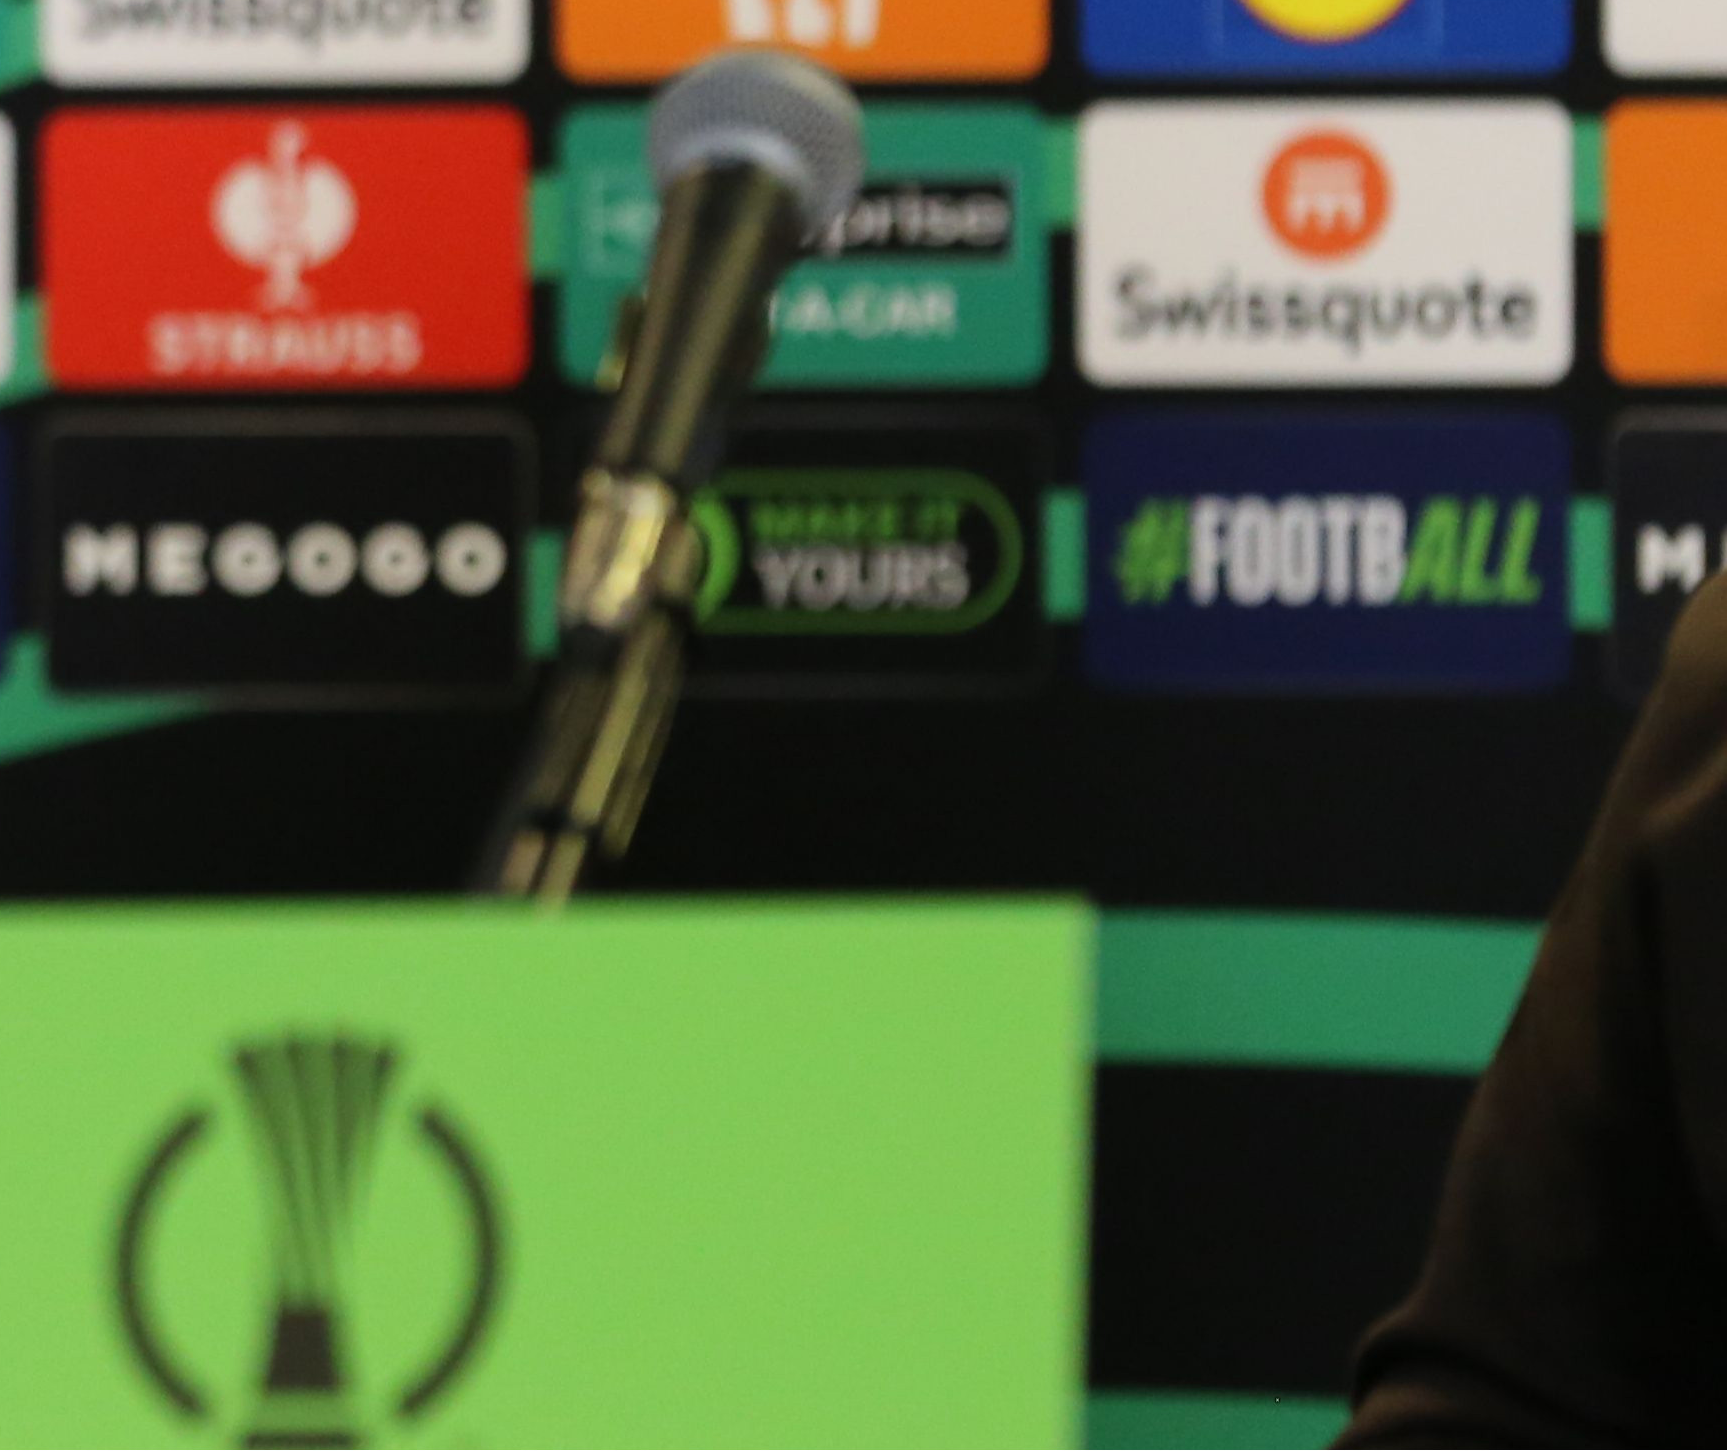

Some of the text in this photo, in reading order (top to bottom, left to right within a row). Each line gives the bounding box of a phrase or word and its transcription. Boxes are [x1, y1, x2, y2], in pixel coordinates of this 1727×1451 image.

[149, 312, 421, 372] STRAUSS
[1112, 264, 1538, 354] Swissquote
[753, 542, 971, 608] YOURS
[1118, 495, 1538, 605] #FOOTBALL
